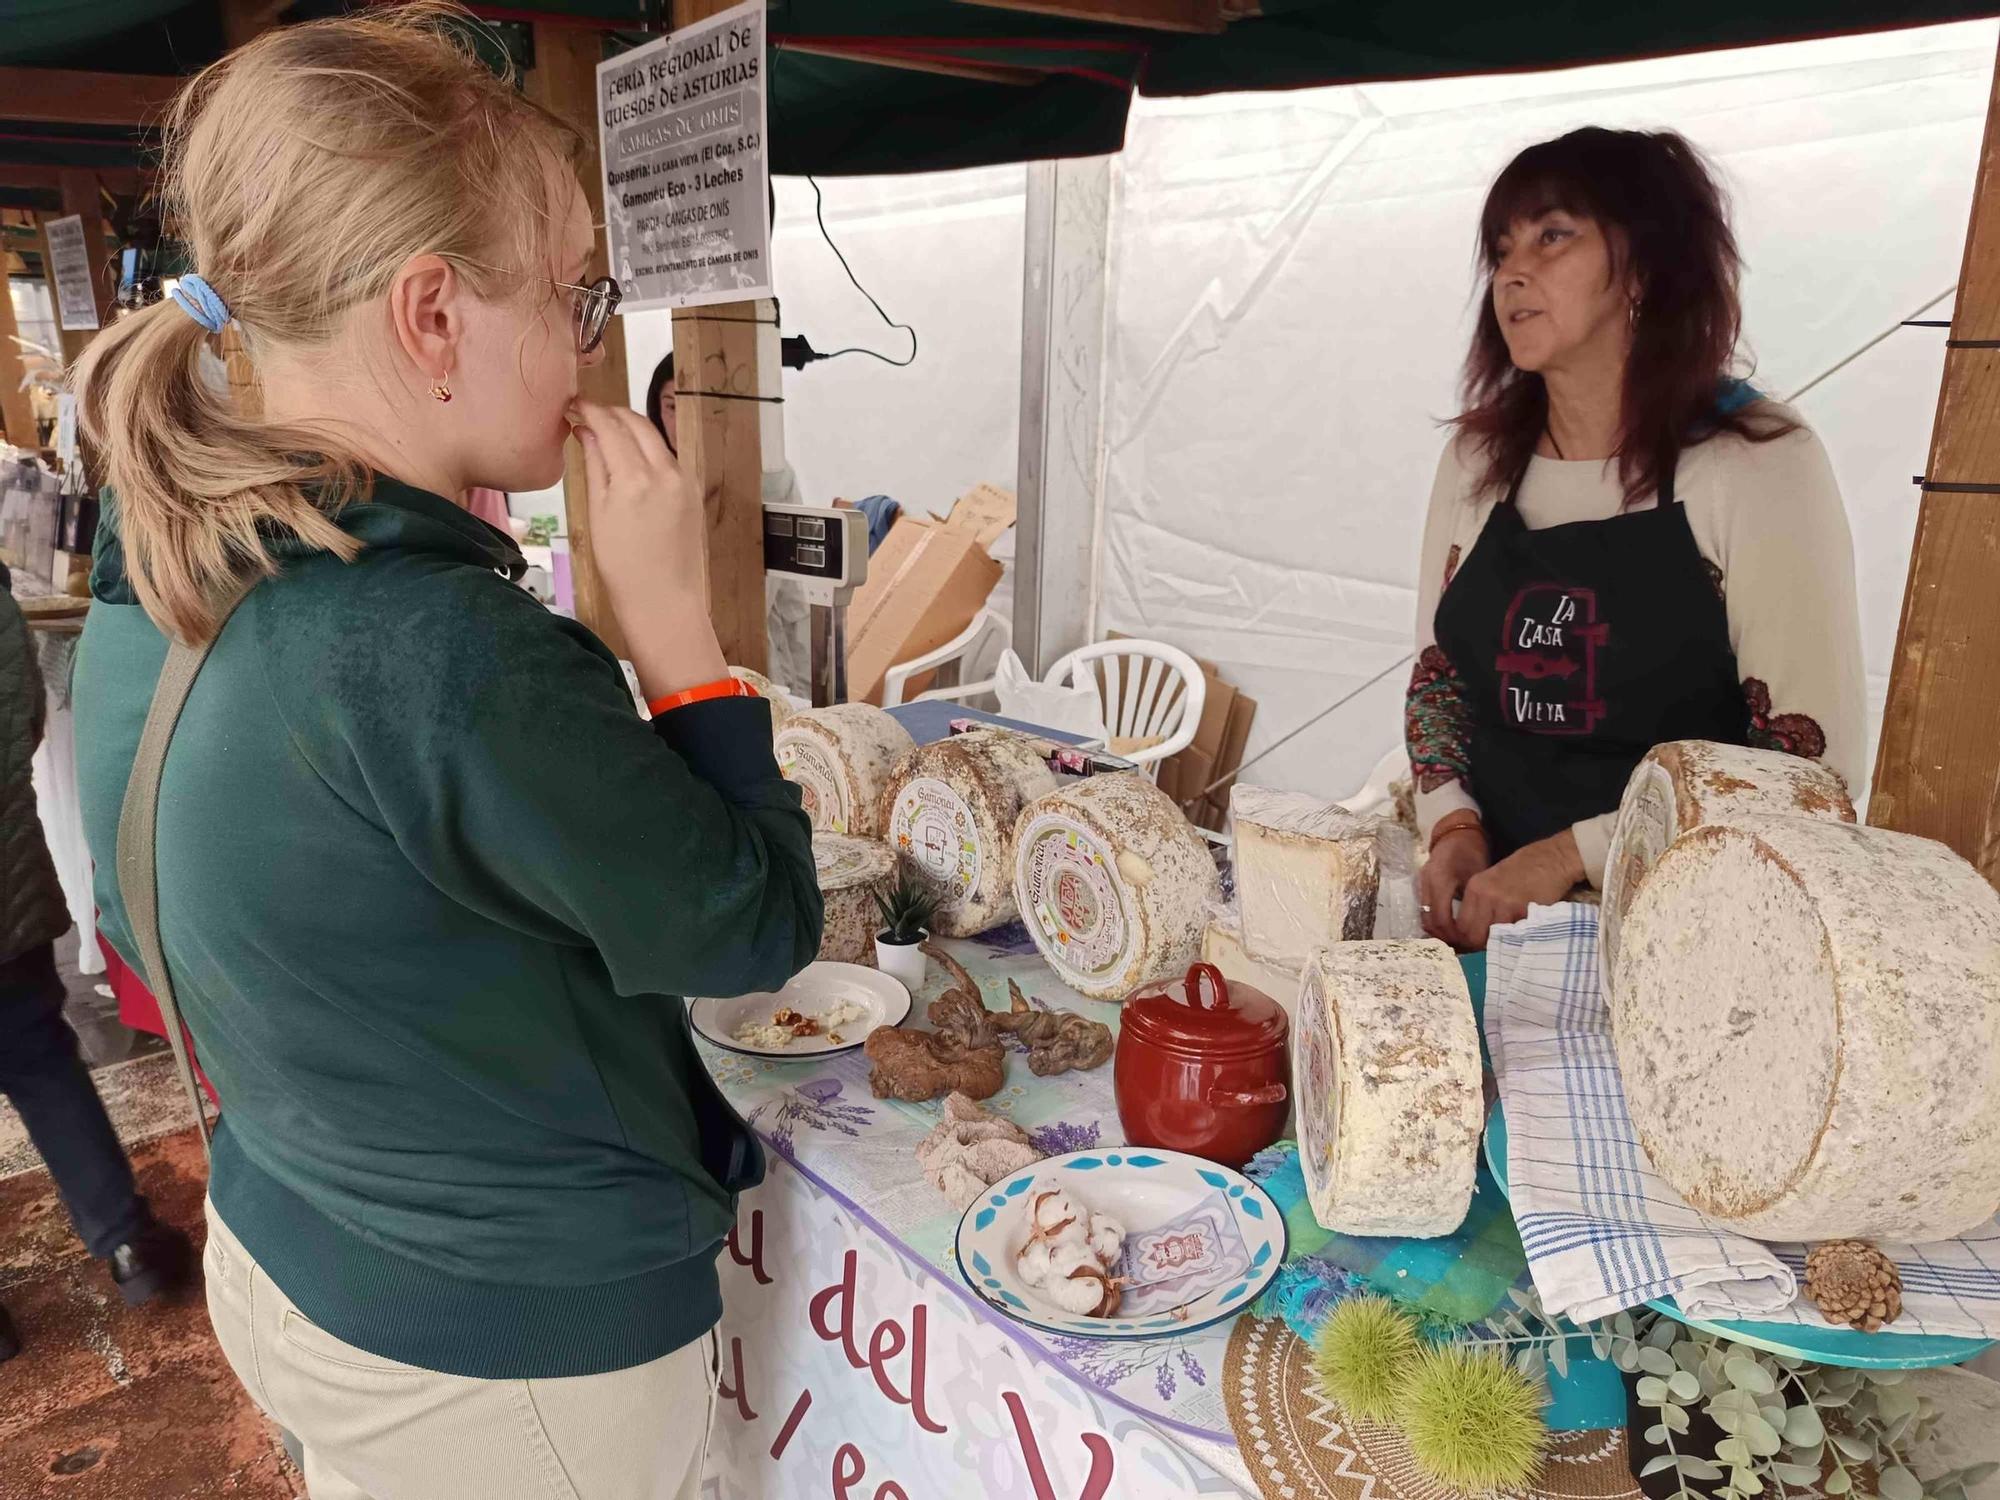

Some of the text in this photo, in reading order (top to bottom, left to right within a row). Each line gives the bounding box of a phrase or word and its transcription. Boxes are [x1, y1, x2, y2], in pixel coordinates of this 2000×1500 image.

[649, 36, 723, 84] REGIONAL
[729, 26, 751, 52] DE
[605, 57, 759, 128] QUESOS DE ASTURIAS
[667, 181, 687, 198] Eco
[695, 174, 702, 191] 3
[704, 168, 744, 189] Leches
[666, 209, 697, 229] CANGAS
[697, 206, 709, 221] DE
[809, 1249, 947, 1434] del
